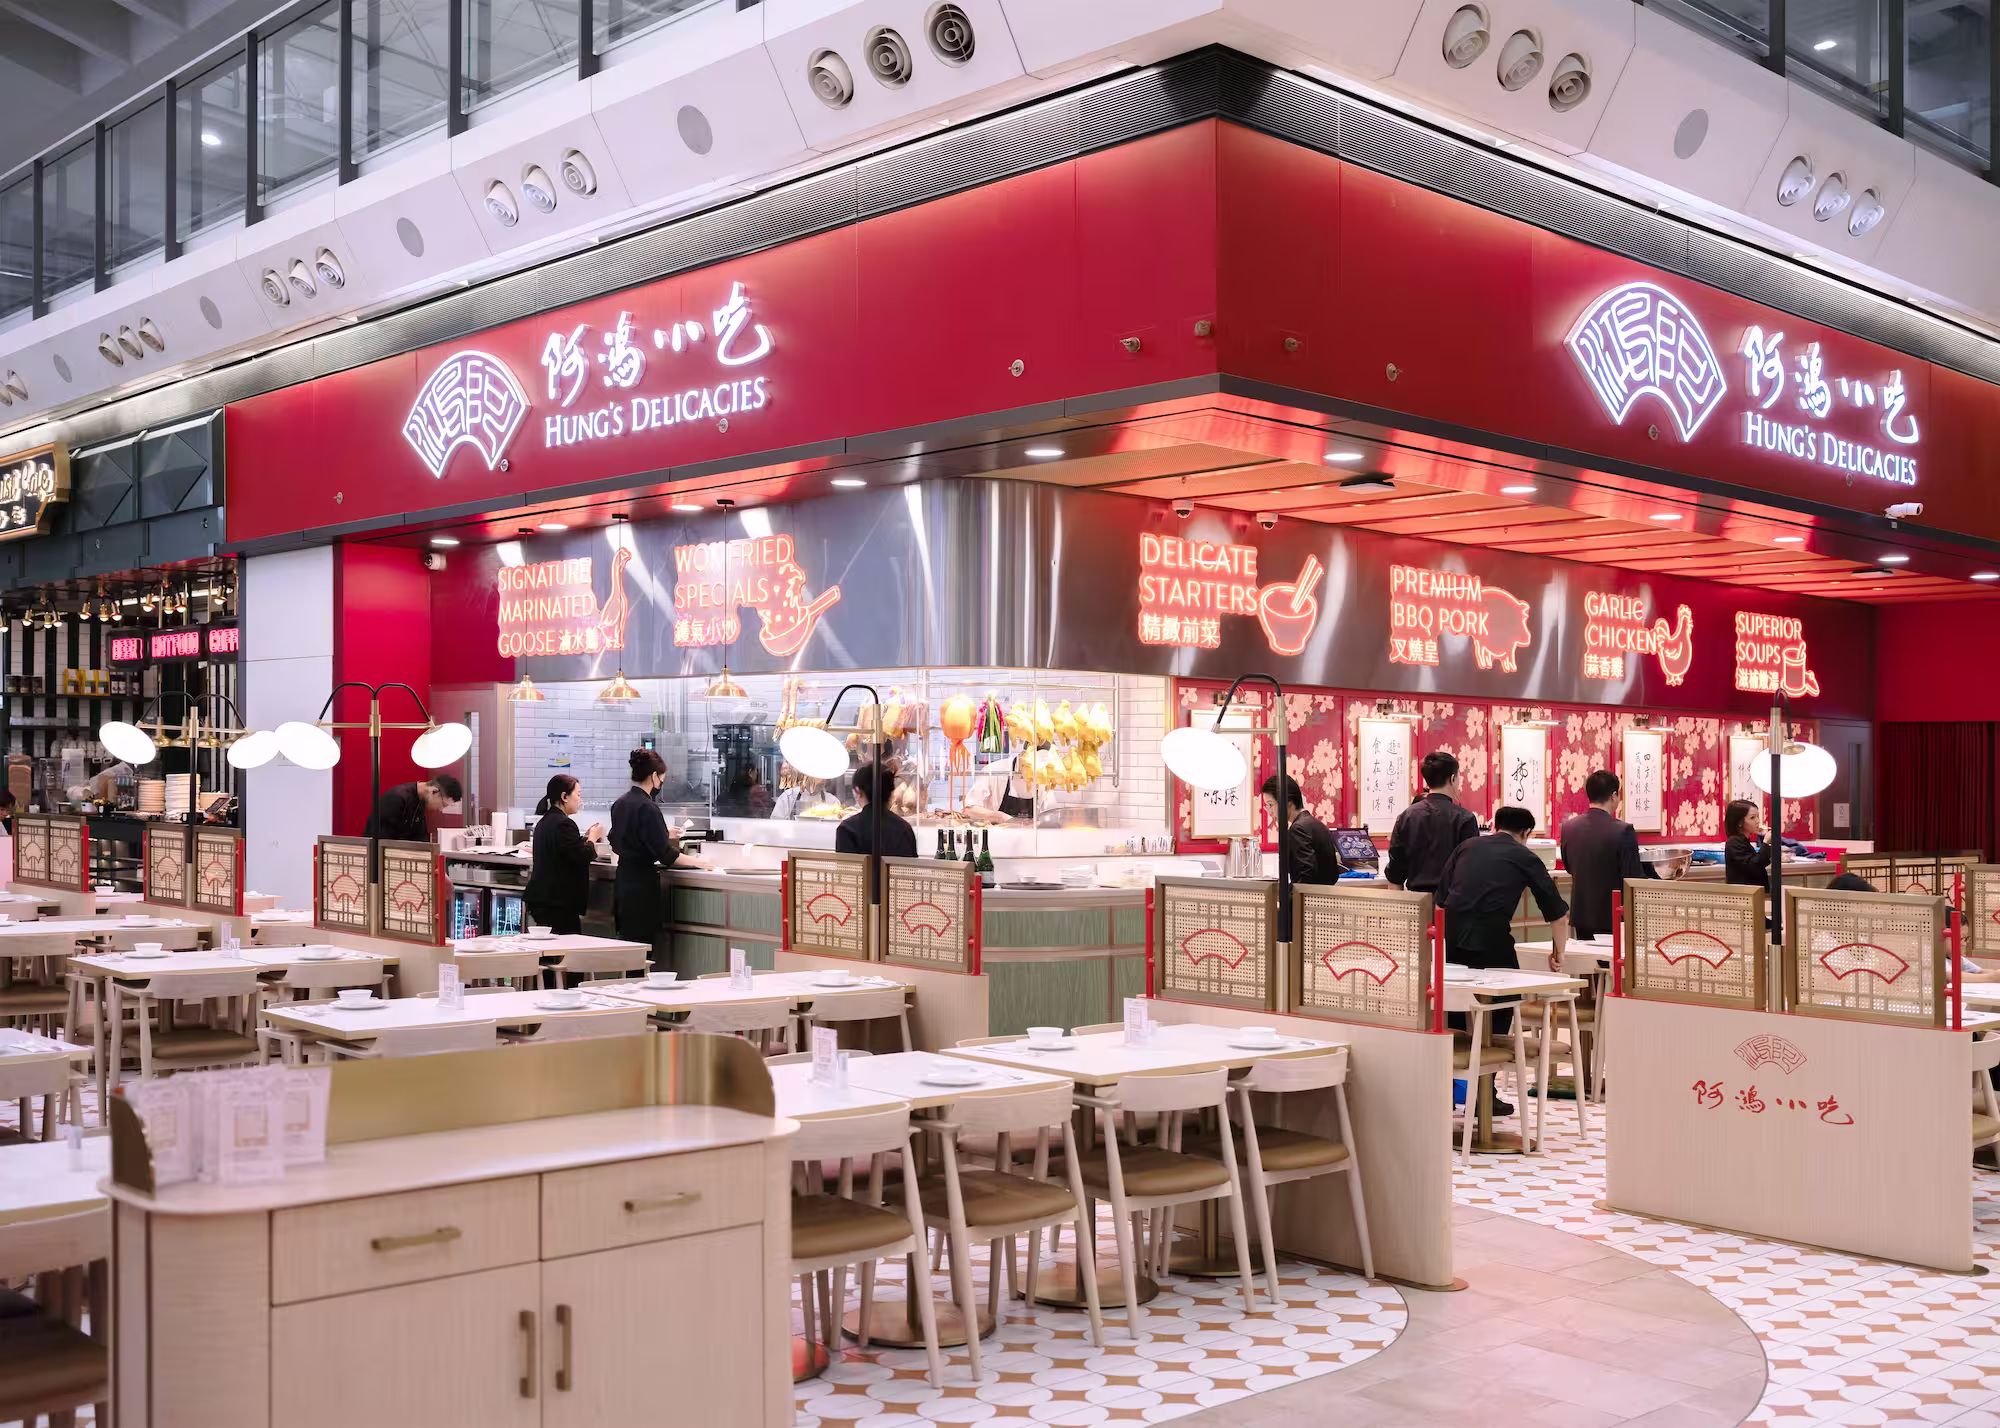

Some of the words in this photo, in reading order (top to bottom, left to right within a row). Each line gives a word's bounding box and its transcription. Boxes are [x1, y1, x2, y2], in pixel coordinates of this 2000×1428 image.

[542, 281, 774, 407] 阿鴻小吃
[1742, 324, 1920, 444] 阿鴻小吃
[631, 376, 766, 434] DELICACIES
[1823, 434, 1917, 486] DELICACIES
[729, 538, 790, 568] FRIED
[1143, 536, 1257, 576] DELICATE
[499, 559, 592, 592] SIGNATURE
[1393, 569, 1482, 600] PREMIUM
[499, 593, 594, 624] MARINATED
[675, 577, 769, 609] SPECIALS
[1142, 577, 1258, 613] STARTERS
[1587, 594, 1644, 619] GARLIC
[1393, 603, 1433, 636] BBQ
[1439, 608, 1490, 636] PORK
[1738, 612, 1802, 640] SUPERIOR
[499, 629, 556, 655] GOOSE
[1391, 637, 1439, 665] 叉燒皇
[1587, 625, 1657, 652] CHICKEN
[1738, 642, 1781, 664] SOUPS
[1691, 1079, 1855, 1125] 阿鴻小吃
